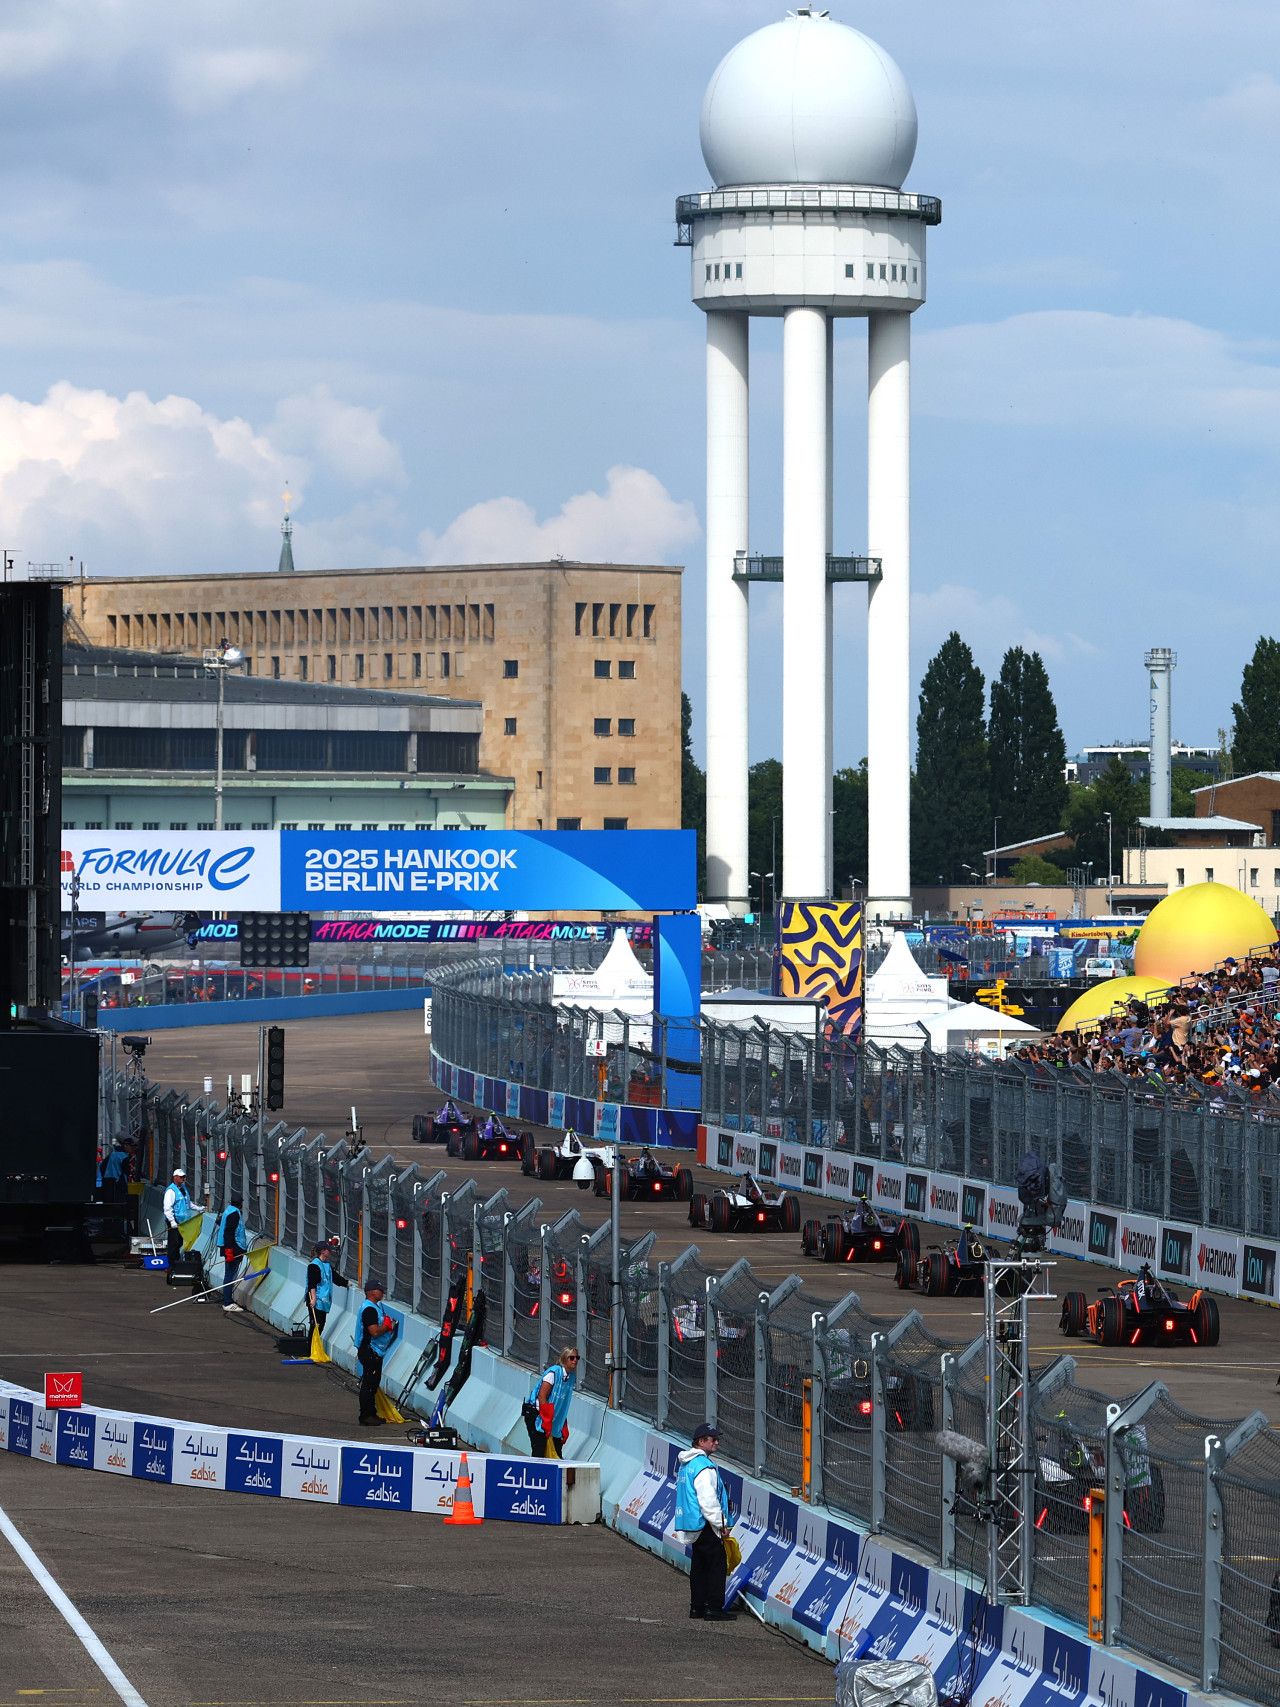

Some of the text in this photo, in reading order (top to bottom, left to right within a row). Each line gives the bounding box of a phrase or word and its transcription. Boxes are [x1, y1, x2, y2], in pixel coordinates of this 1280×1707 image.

[78, 847, 211, 877] FORMULA
[305, 849, 517, 869] 2025 HANKOOK
[106, 882, 203, 891] CHAMPIONSHIP
[305, 871, 499, 892] BERLIN E-PRIX
[196, 924, 238, 938] MOD
[1164, 1231, 1180, 1265] iON
[1247, 1249, 1263, 1285] iON
[69, 1442, 88, 1461] sabic
[107, 1449, 127, 1468] sabic
[145, 1455, 166, 1475] sabic
[190, 1462, 217, 1482] sabic
[244, 1468, 273, 1489] sabic
[301, 1475, 328, 1495] sabic
[365, 1482, 401, 1503] sabic
[510, 1495, 546, 1516] sabic
